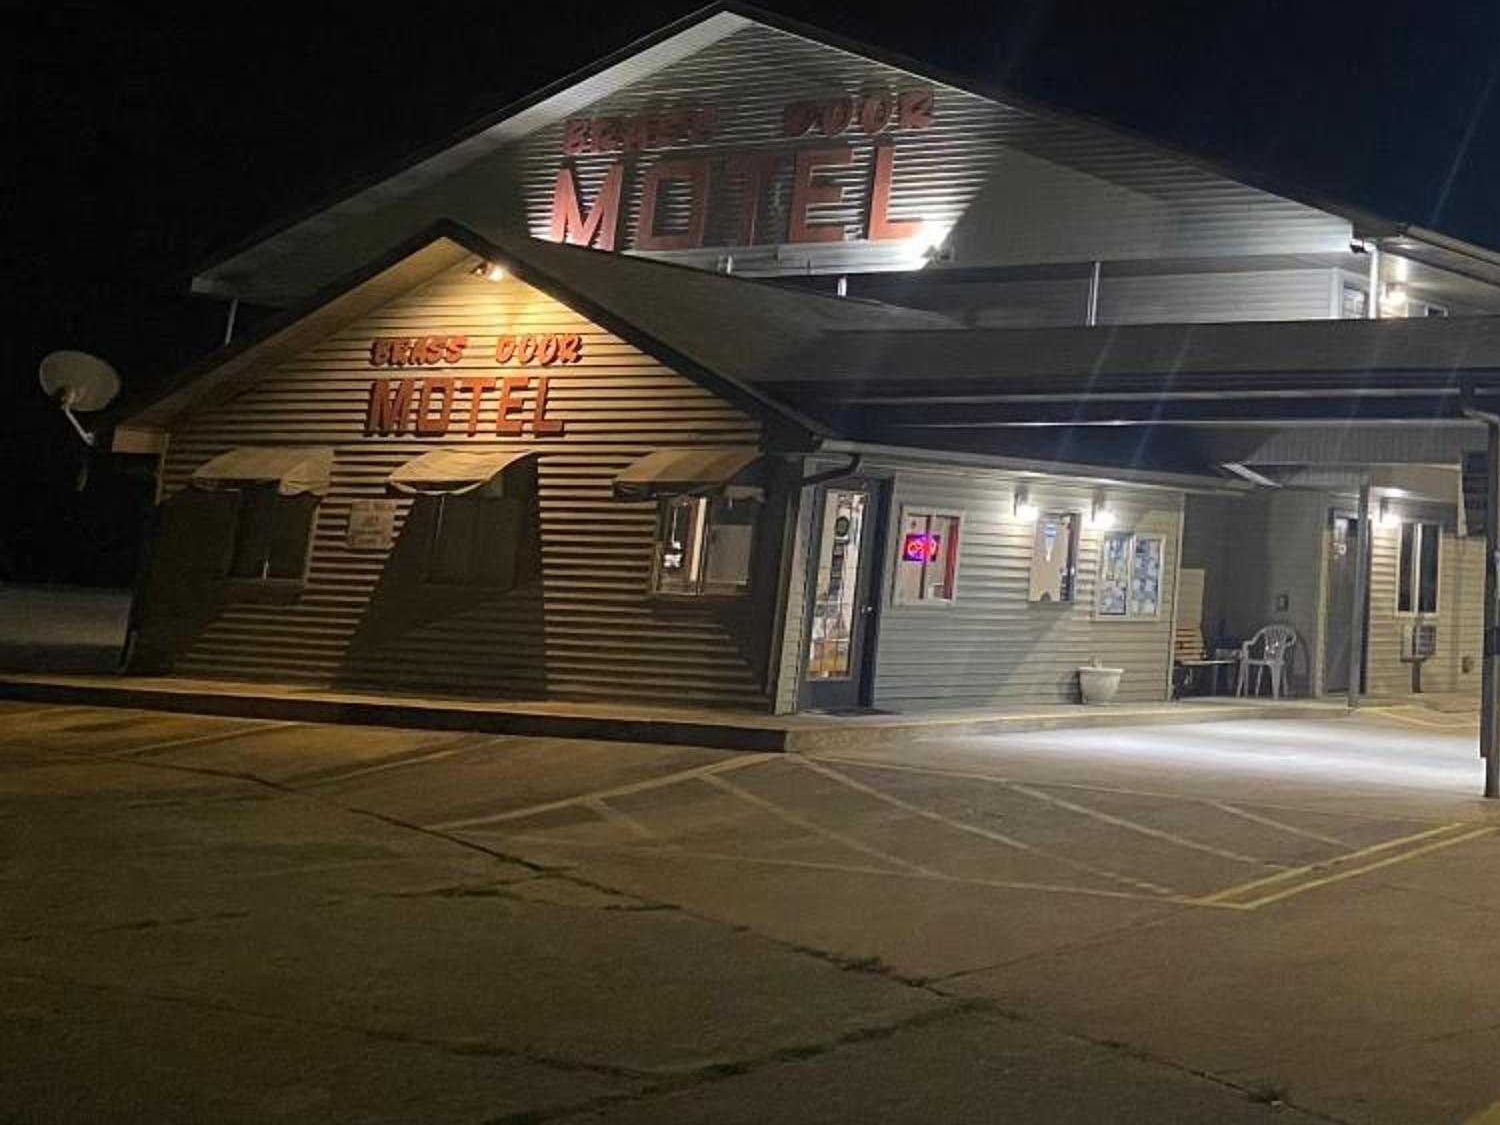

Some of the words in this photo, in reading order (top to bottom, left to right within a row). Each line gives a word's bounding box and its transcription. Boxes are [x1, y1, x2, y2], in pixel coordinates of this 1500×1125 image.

[548, 143, 928, 251] MOTEL
[496, 333, 582, 366] DOOR
[364, 377, 566, 437] MOTEL
